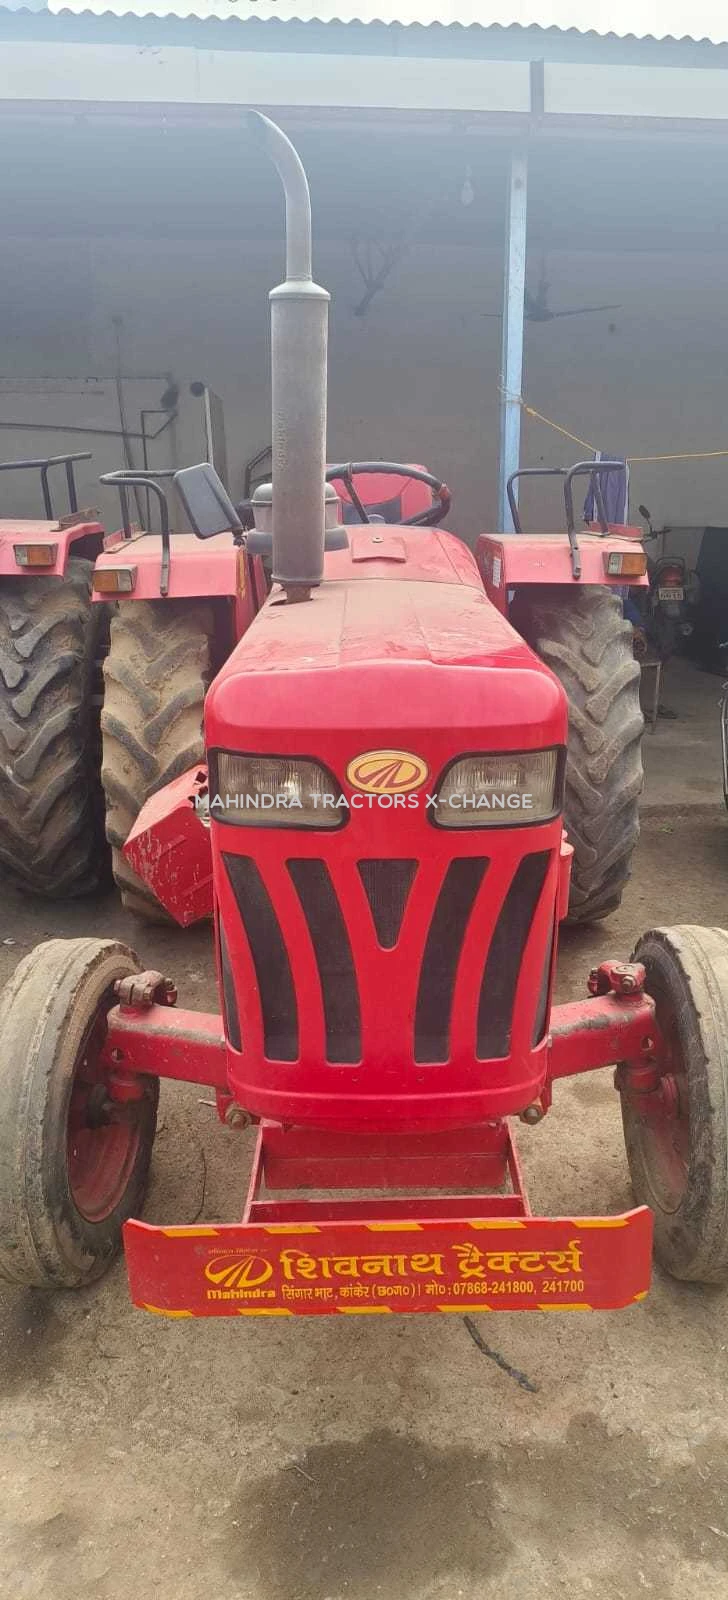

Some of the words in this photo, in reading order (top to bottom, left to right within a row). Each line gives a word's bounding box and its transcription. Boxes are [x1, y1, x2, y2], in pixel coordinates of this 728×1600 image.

[279, 1248, 445, 1280] शिवनाथ
[450, 1240, 583, 1279] ट्रैक्टर्स
[542, 1280, 584, 1293] 241700
[207, 1288, 276, 1300] Mahindra
